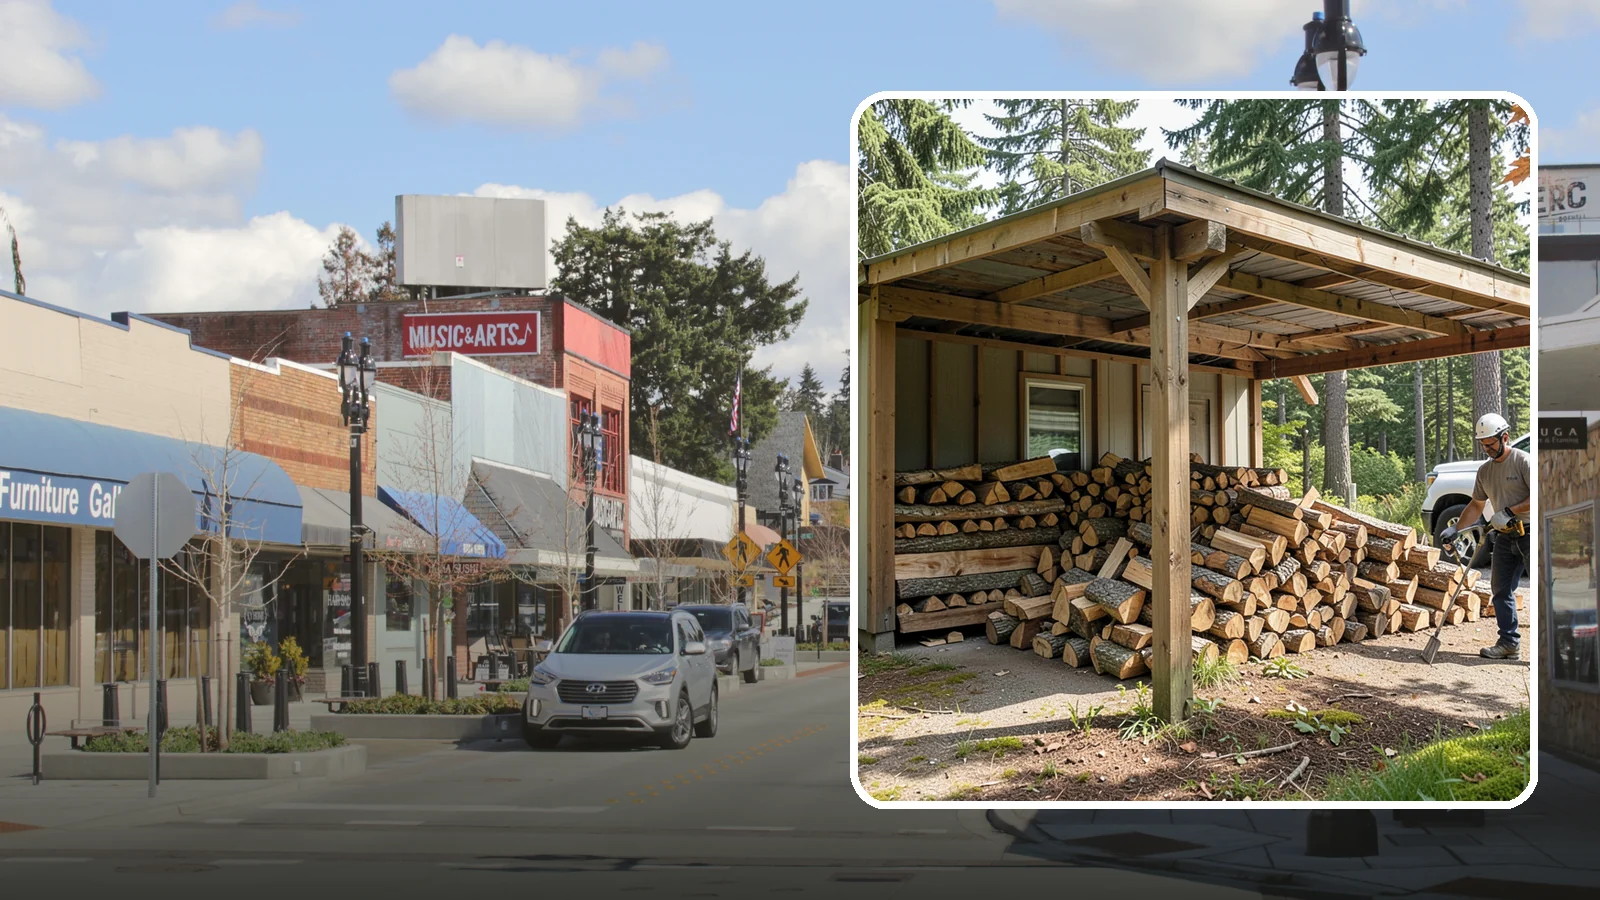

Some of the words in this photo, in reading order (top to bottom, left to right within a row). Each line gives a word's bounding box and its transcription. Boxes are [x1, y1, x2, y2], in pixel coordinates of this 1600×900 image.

[0, 471, 79, 515] Furniture
[90, 482, 122, 518] Gal
[453, 562, 480, 573] SUSHI
